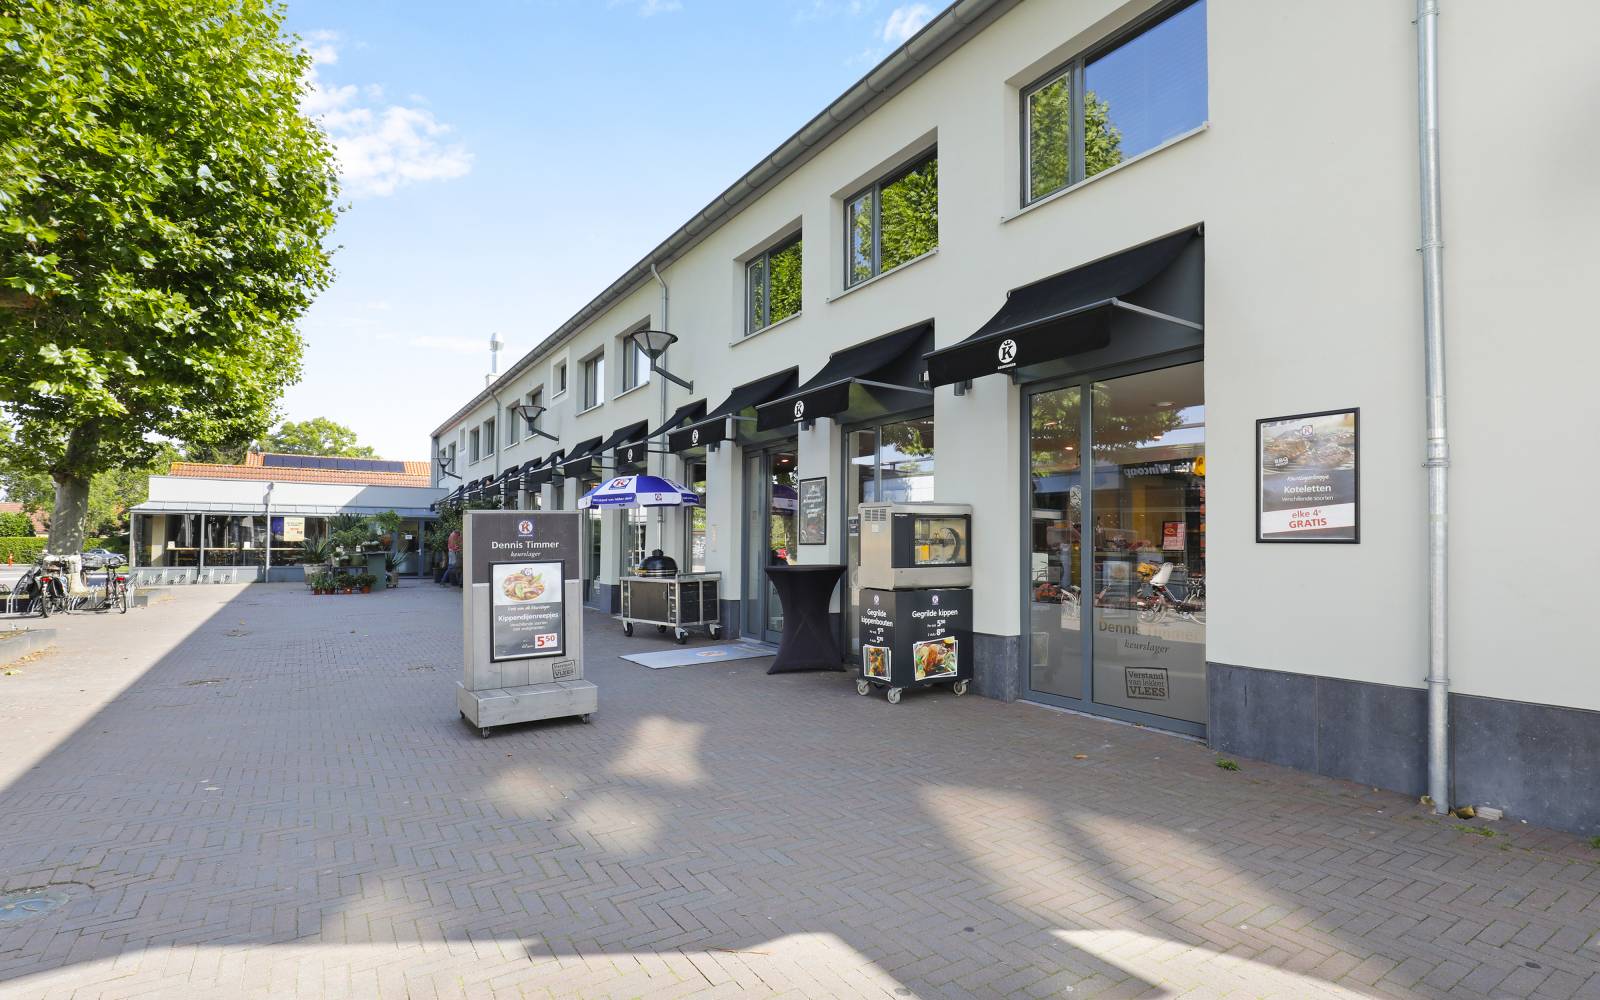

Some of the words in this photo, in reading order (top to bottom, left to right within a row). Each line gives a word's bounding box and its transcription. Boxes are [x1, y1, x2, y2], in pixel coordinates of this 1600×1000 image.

[1284, 485, 1332, 493] Koteletten
[1292, 510, 1310, 518] elke
[1289, 518, 1328, 529] GRATIS
[491, 541, 523, 549] Dennis
[525, 541, 559, 549] Timmer
[912, 610, 937, 619] Gegrilde
[938, 609, 958, 618] kippen
[1124, 639, 1169, 655] keurslager
[1128, 671, 1164, 680] Verstand
[1128, 686, 1166, 697] VLEES
